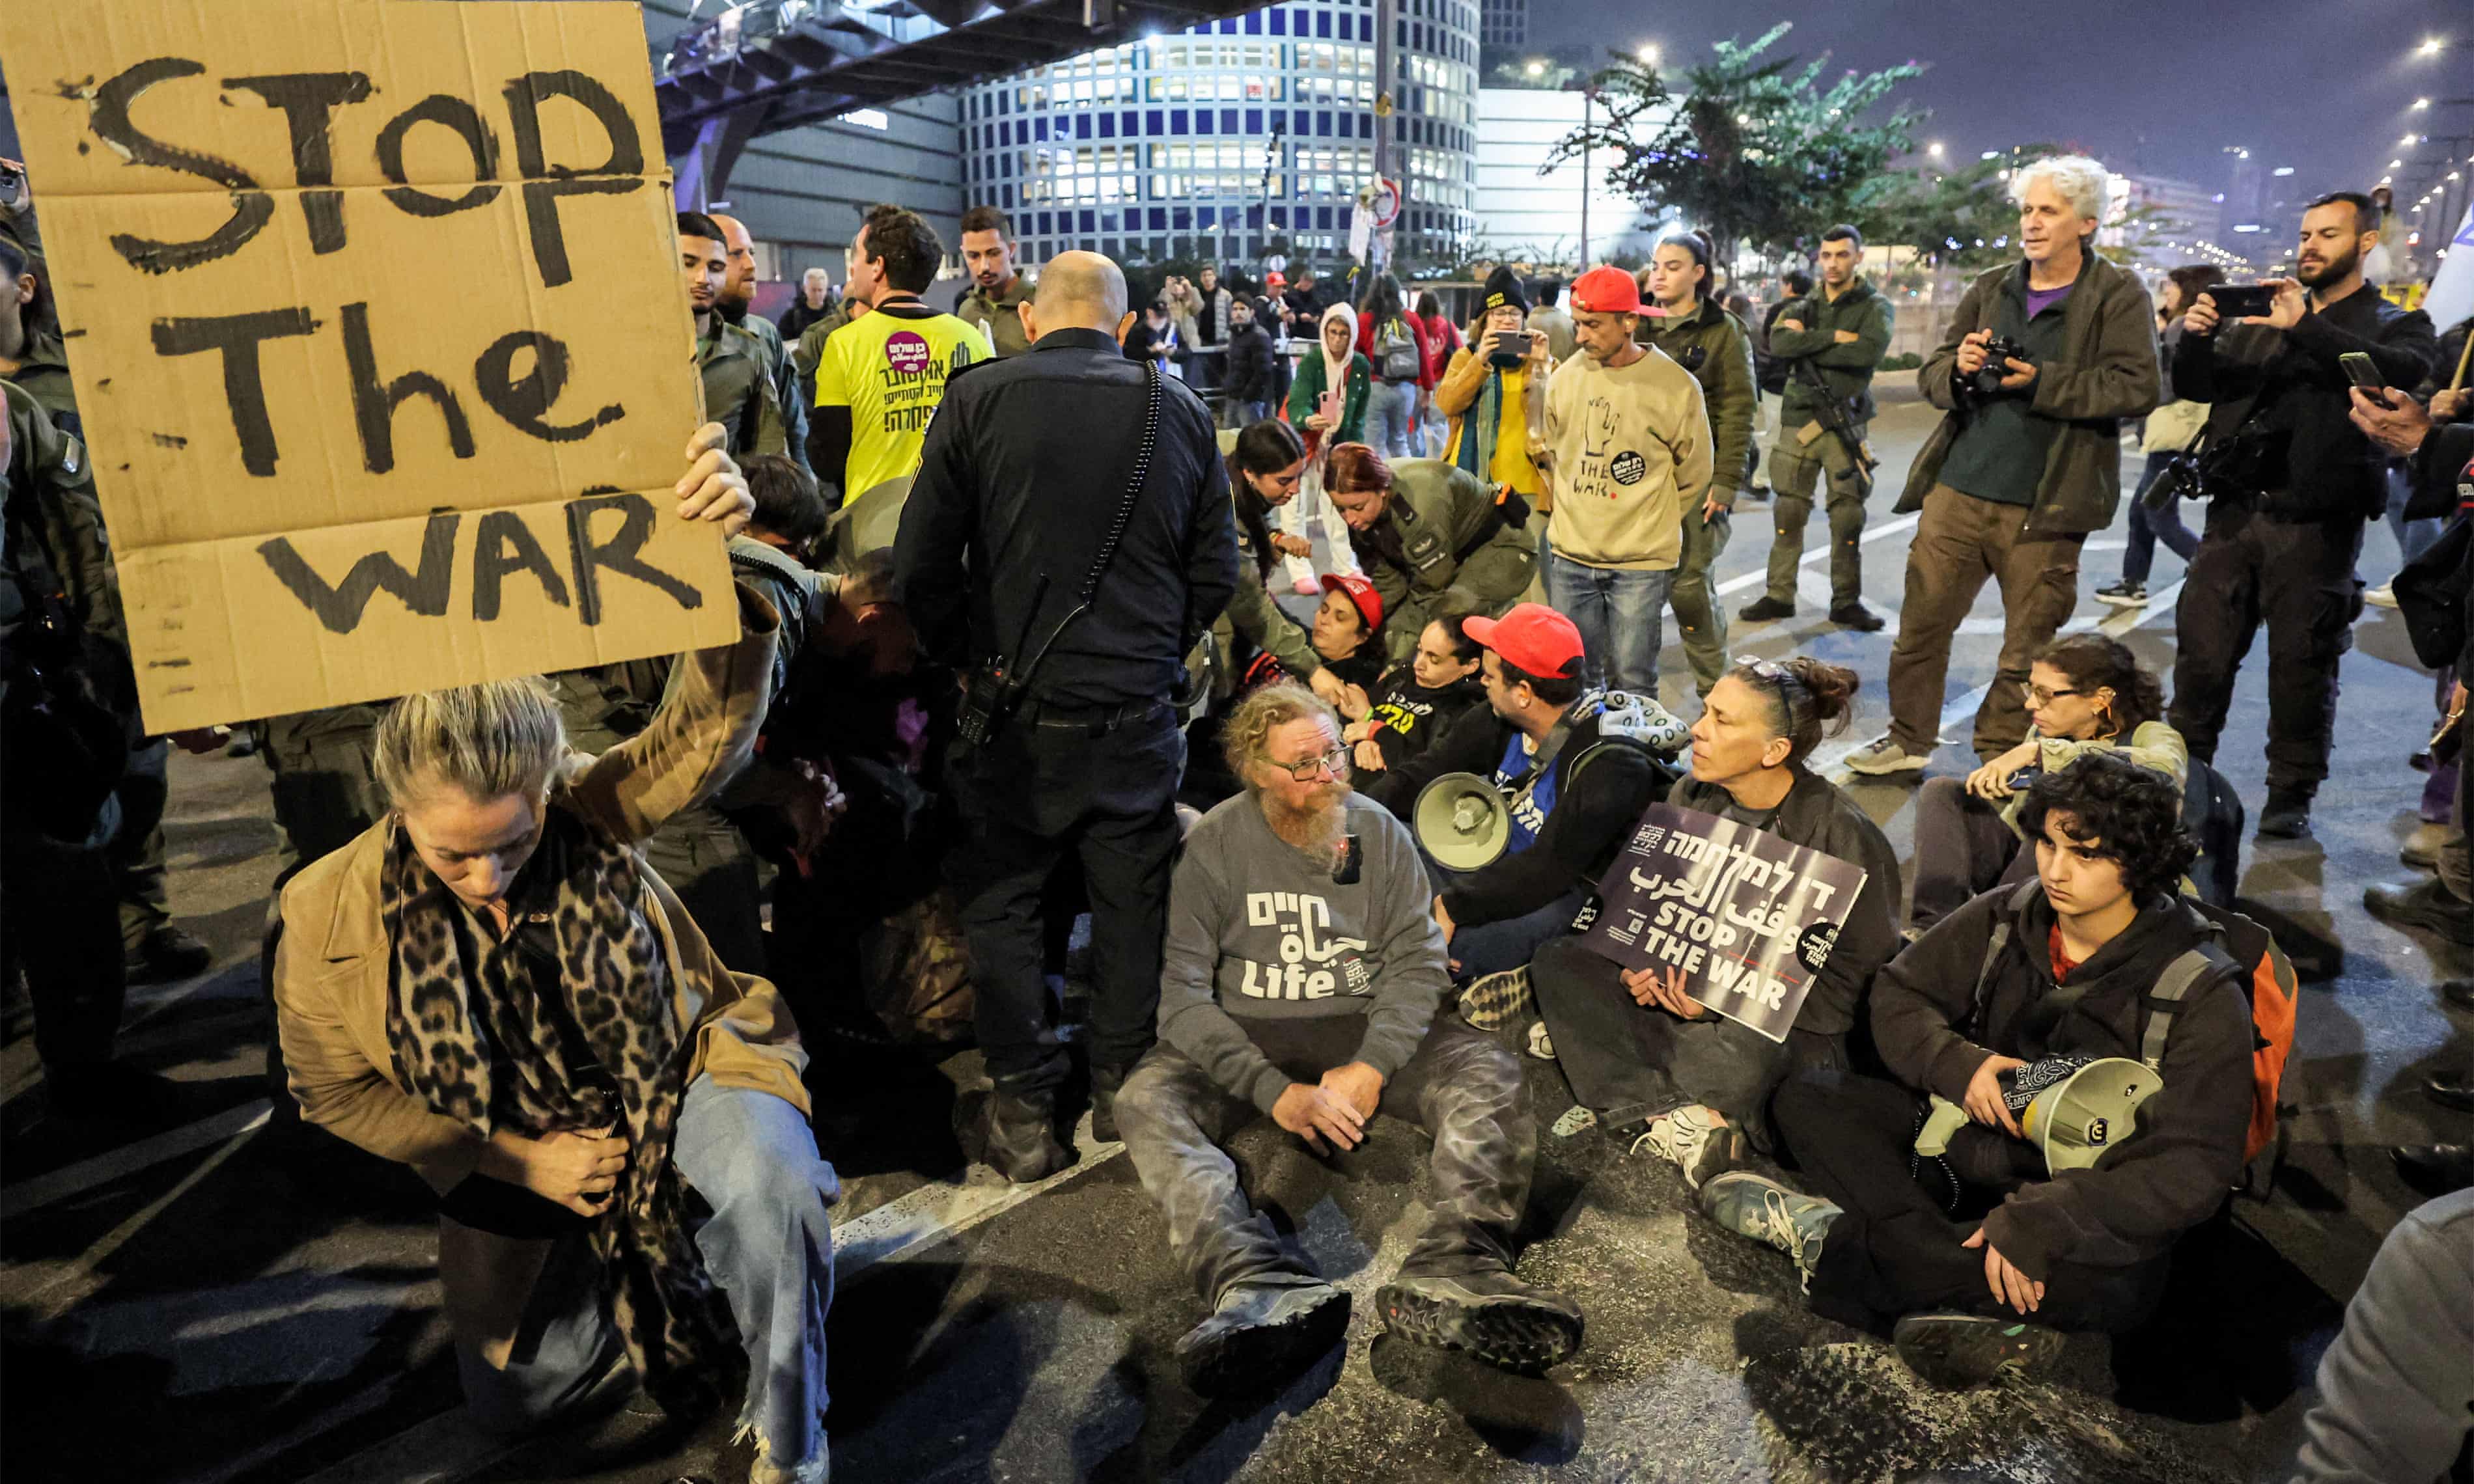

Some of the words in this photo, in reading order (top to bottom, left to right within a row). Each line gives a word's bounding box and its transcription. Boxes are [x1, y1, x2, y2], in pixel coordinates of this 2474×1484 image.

[150, 301, 626, 478] The
[1580, 460, 1610, 479] THE
[257, 485, 702, 635] WAR
[1653, 901, 1738, 950] STOP
[1242, 960, 1335, 1000] Life
[1644, 926, 1707, 975] THE
[1707, 955, 1788, 1011] WAR
